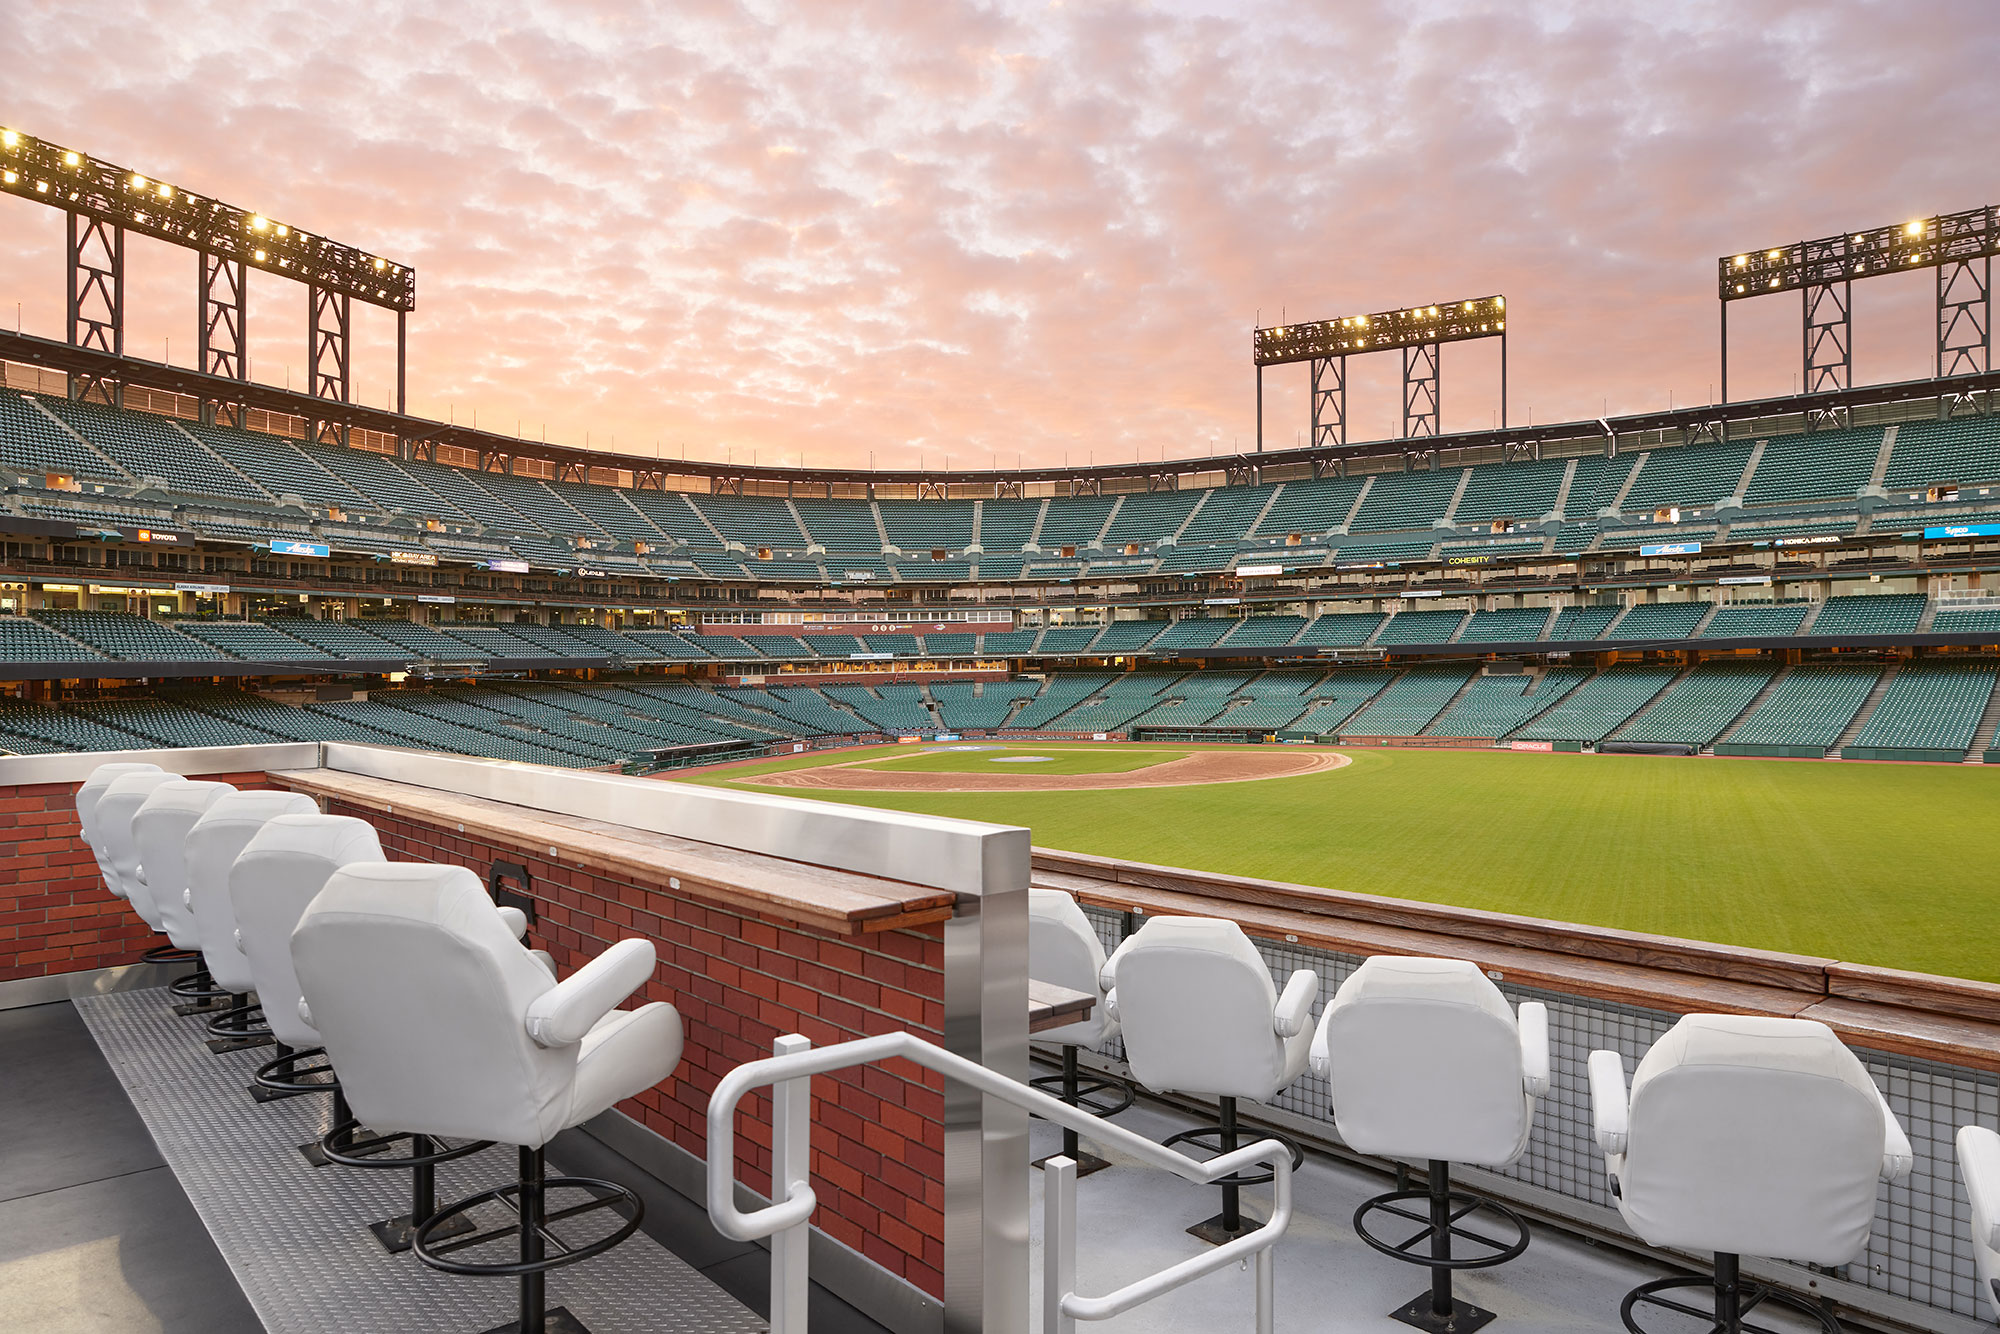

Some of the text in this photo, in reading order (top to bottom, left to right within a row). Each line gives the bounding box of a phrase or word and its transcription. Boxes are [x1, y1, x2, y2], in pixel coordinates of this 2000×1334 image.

[151, 533, 178, 542] TOYOTA
[1810, 536, 1840, 544] MINOLTA
[286, 543, 316, 555] Alaska
[1656, 544, 1686, 554] Alaska
[1448, 556, 1490, 565] COHESITY
